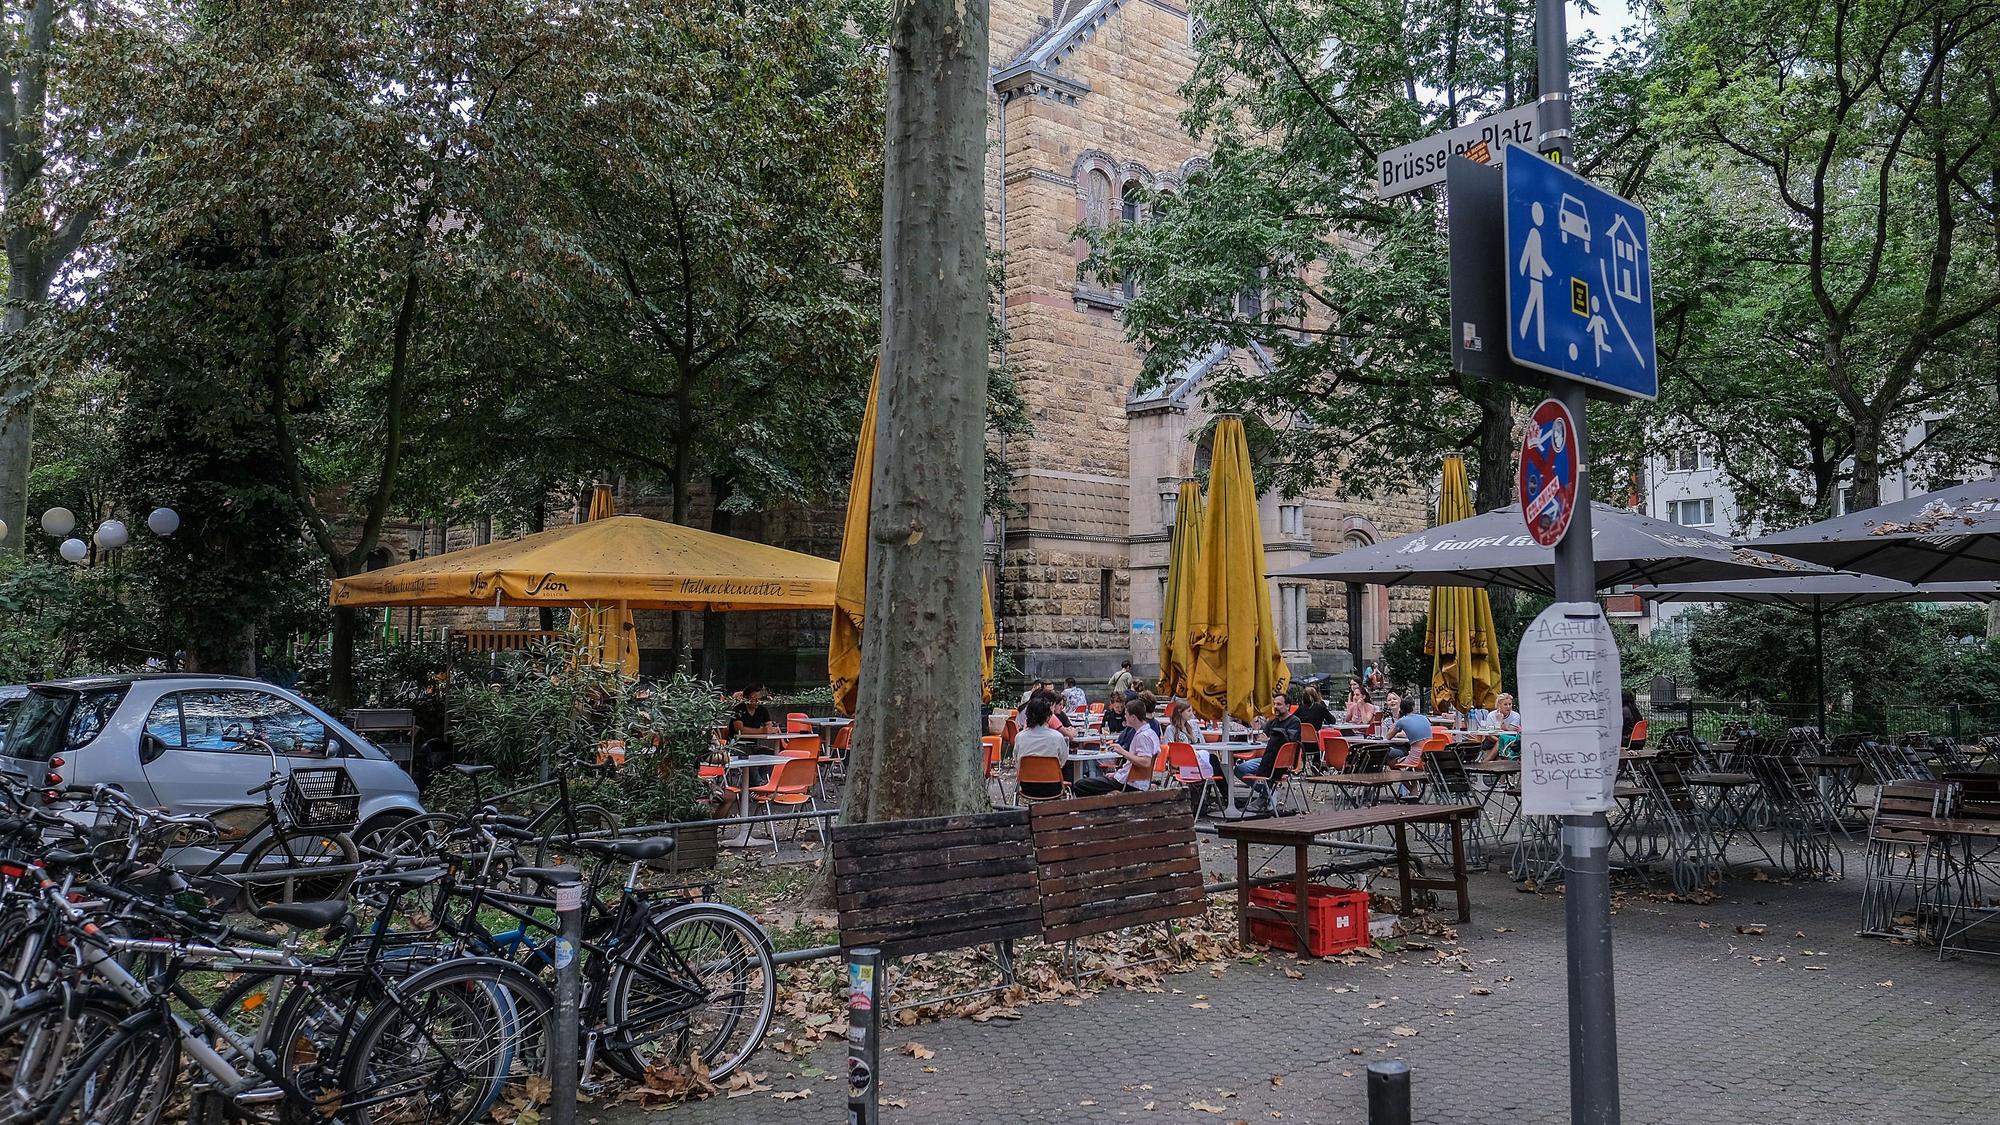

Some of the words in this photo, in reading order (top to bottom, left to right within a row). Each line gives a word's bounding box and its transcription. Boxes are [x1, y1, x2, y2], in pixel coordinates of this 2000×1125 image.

[1482, 119, 1533, 151] Platz
[524, 571, 570, 596] Sion
[1530, 742, 1577, 767] PLEASE
[1578, 751, 1598, 764] DO
[1532, 768, 1604, 790] BICYCLES
